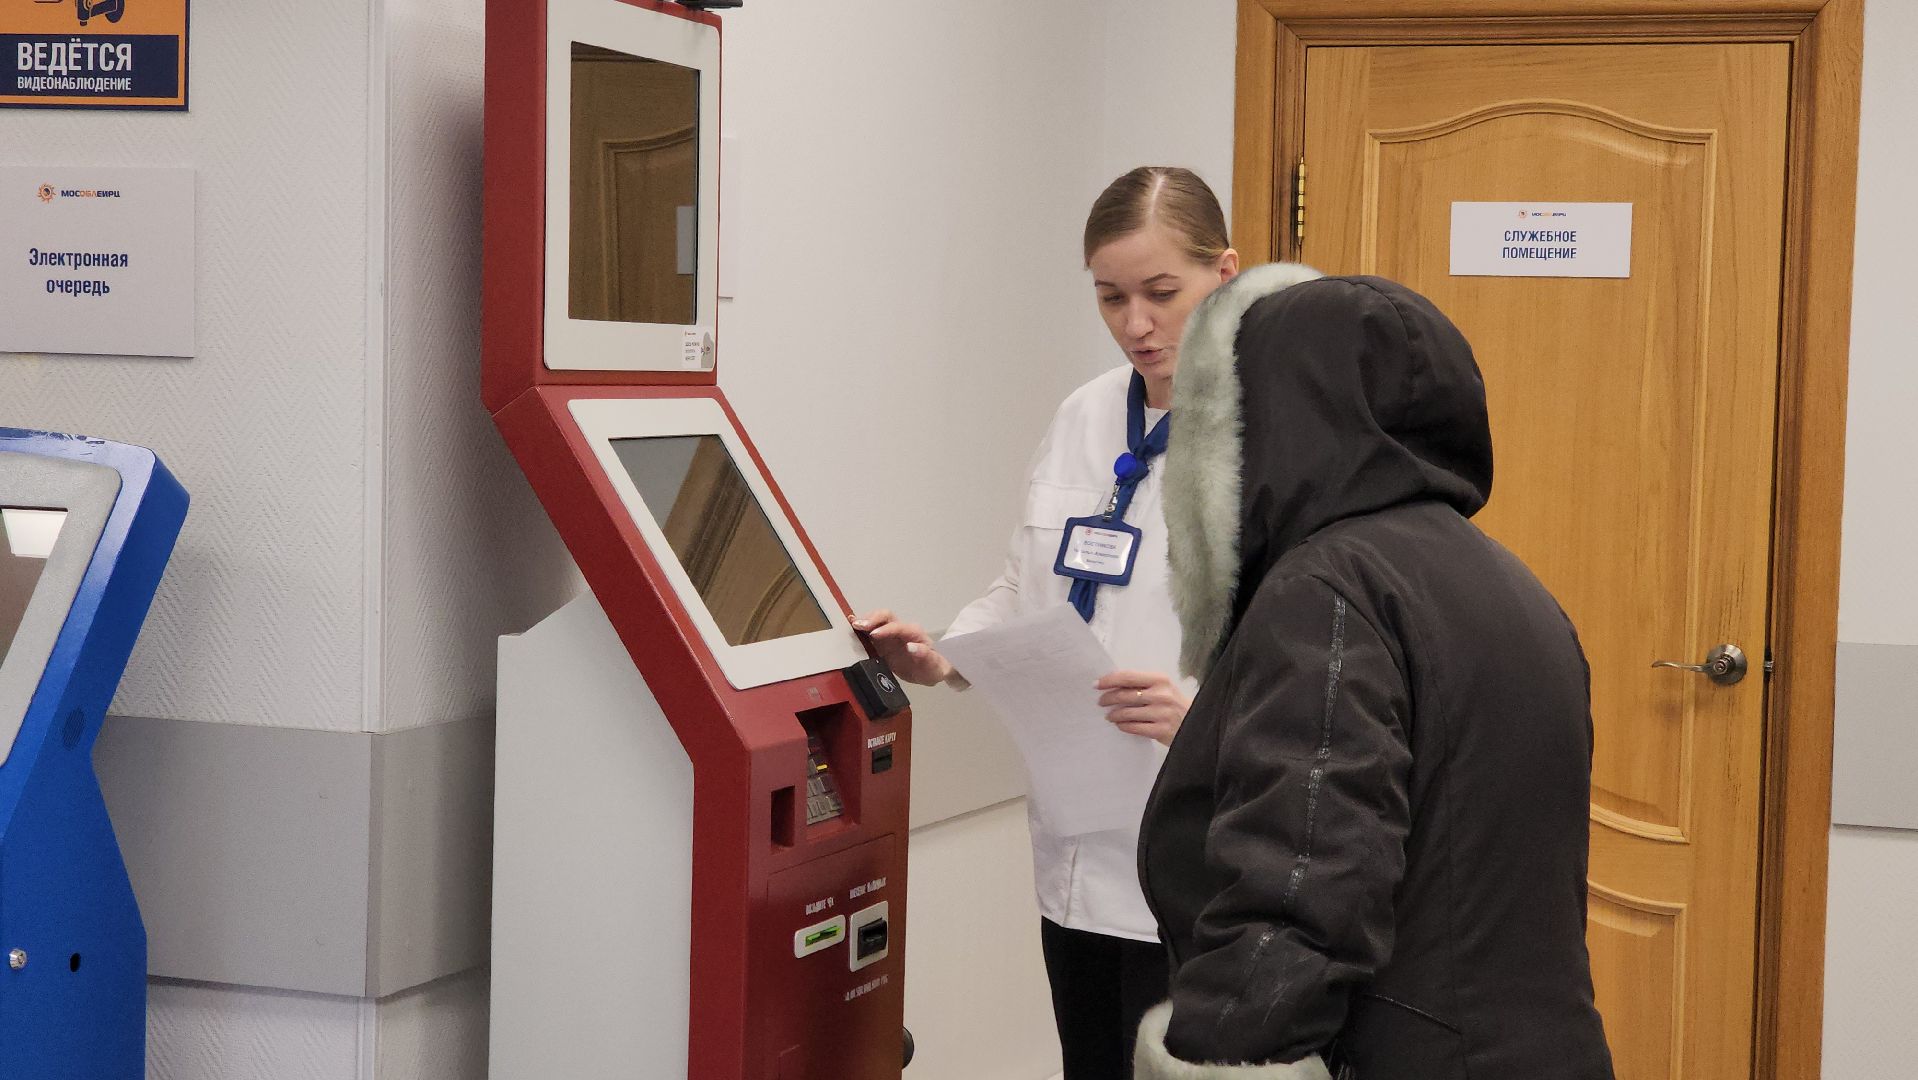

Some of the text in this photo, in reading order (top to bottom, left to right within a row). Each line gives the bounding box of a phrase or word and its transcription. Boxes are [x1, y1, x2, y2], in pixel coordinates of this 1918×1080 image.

[17, 38, 132, 76] ВЕДЁТСЯ
[17, 76, 132, 92] ВИДЕОНАБЛЮДЕНИЕ
[61, 189, 121, 198] МОСОБЛЕИРЦ
[1504, 230, 1577, 243] СЛУЖЕБНОЕ
[29, 247, 129, 270] Электронная
[1502, 247, 1577, 260] ПОМЕЩЕНИЕ
[46, 279, 110, 297] очередь
